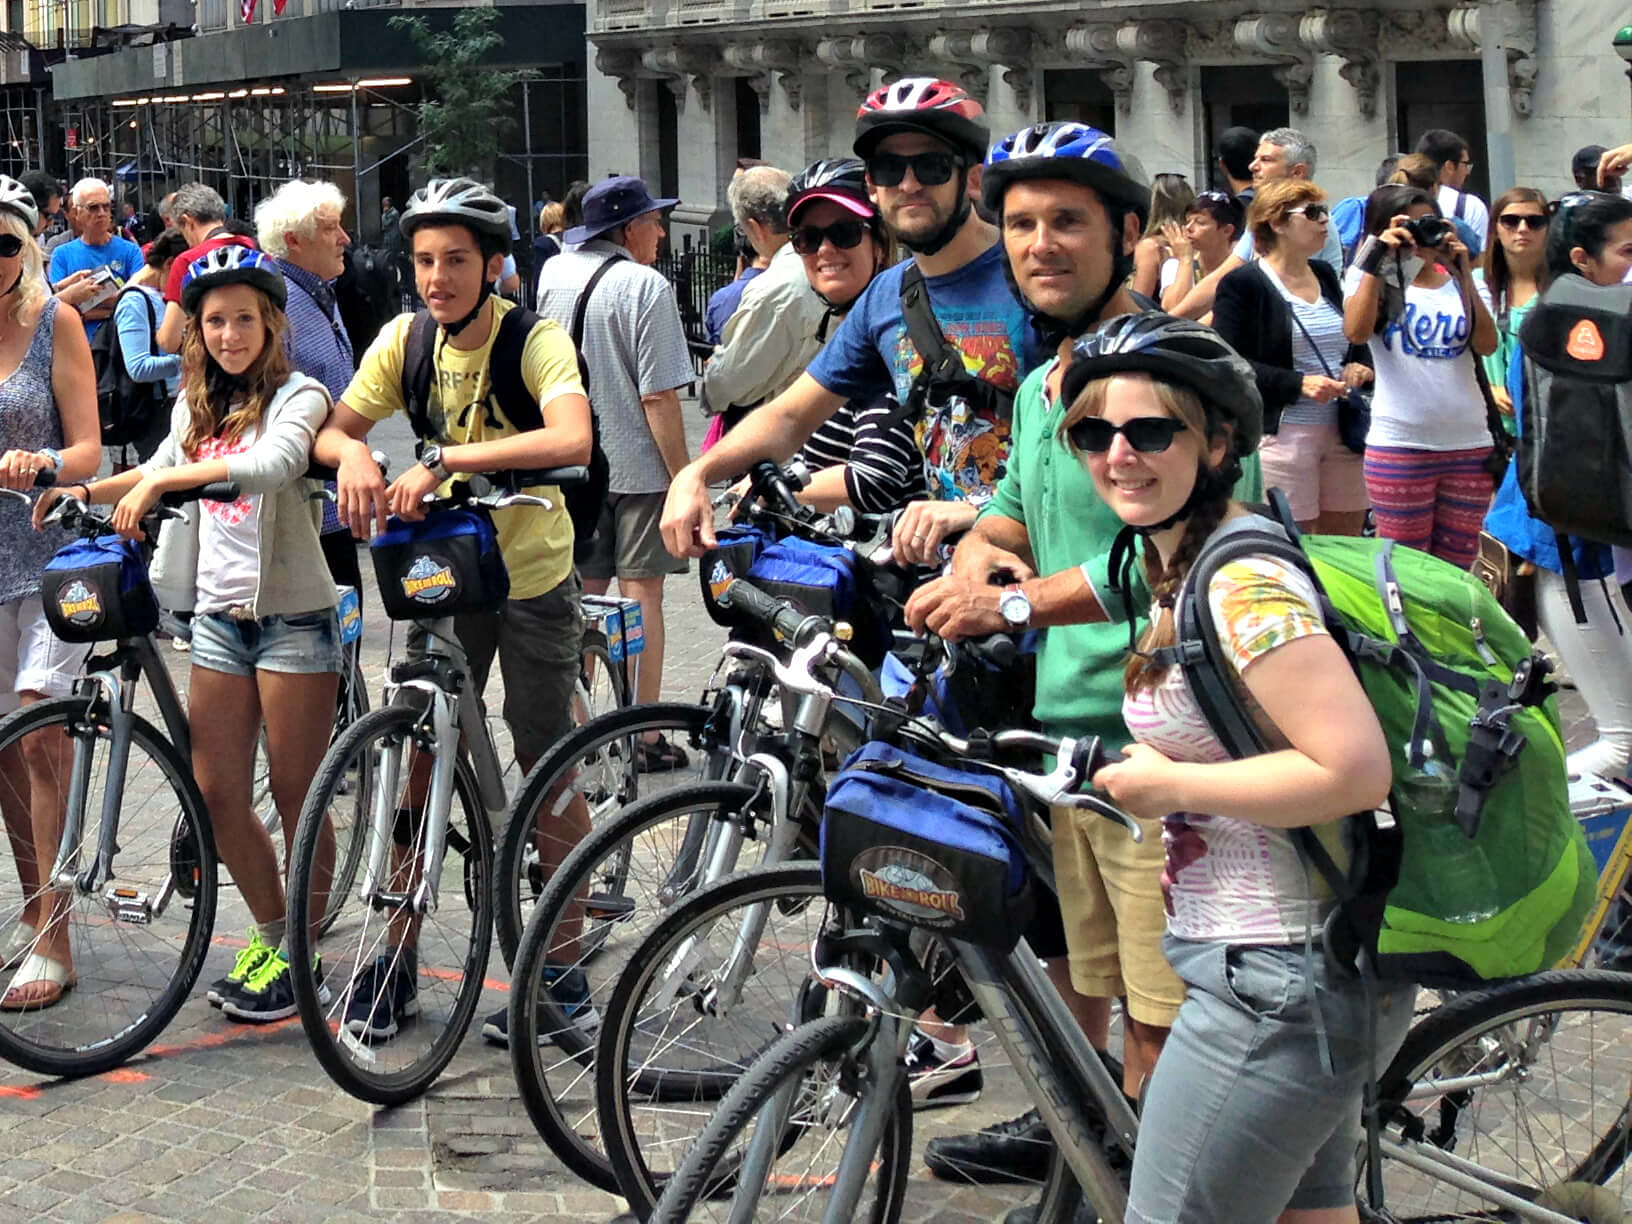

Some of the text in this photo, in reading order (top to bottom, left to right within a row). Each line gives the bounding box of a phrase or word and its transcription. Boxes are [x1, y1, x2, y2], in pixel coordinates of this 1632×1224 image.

[439, 370, 481, 390] RF'S
[865, 875, 899, 898] BIKE
[919, 891, 959, 912] ROLL
